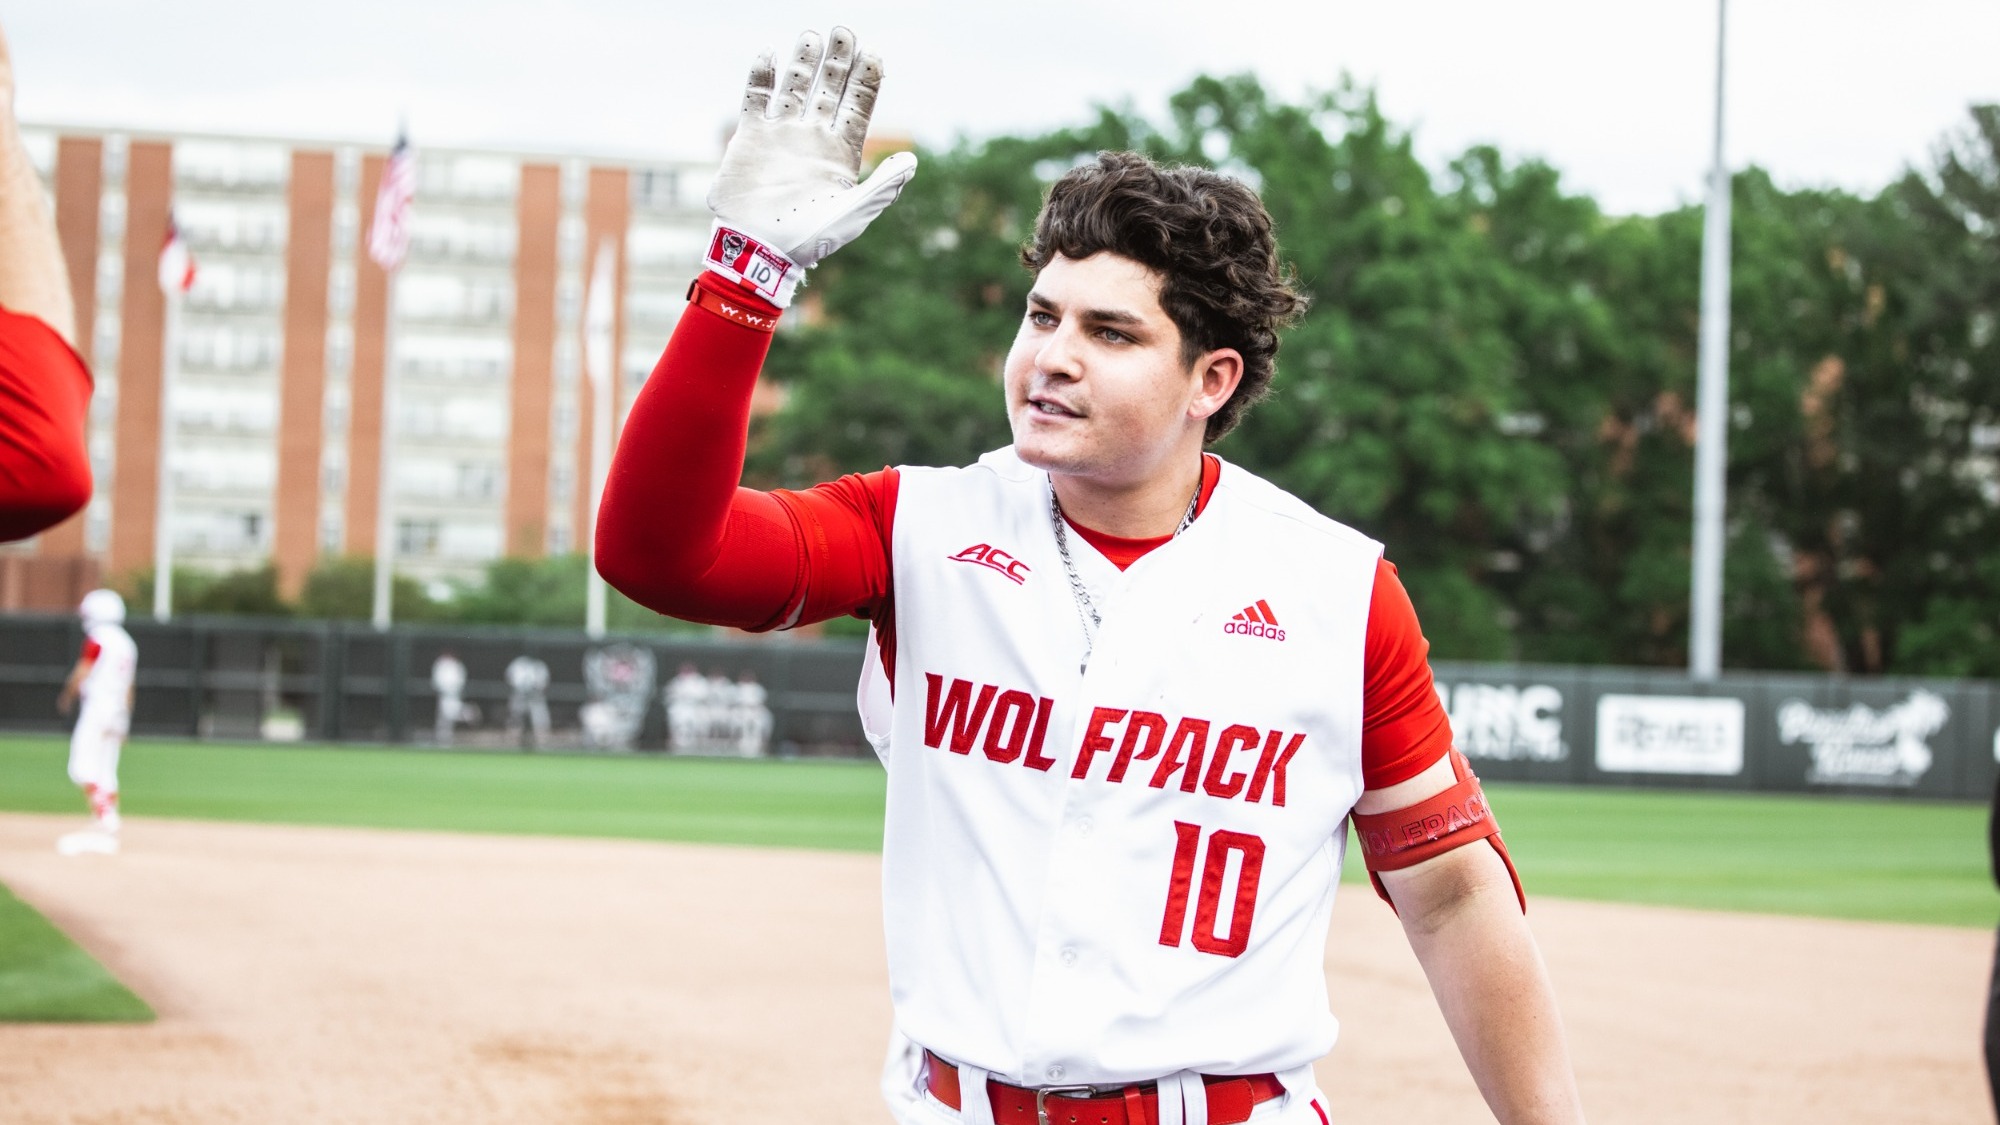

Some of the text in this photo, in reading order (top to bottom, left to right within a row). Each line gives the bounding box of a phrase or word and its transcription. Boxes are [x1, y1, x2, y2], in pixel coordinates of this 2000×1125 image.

[750, 262, 771, 284] 10
[947, 543, 1031, 585] ACC
[1223, 620, 1286, 642] adidas
[1158, 820, 1266, 958] 10
